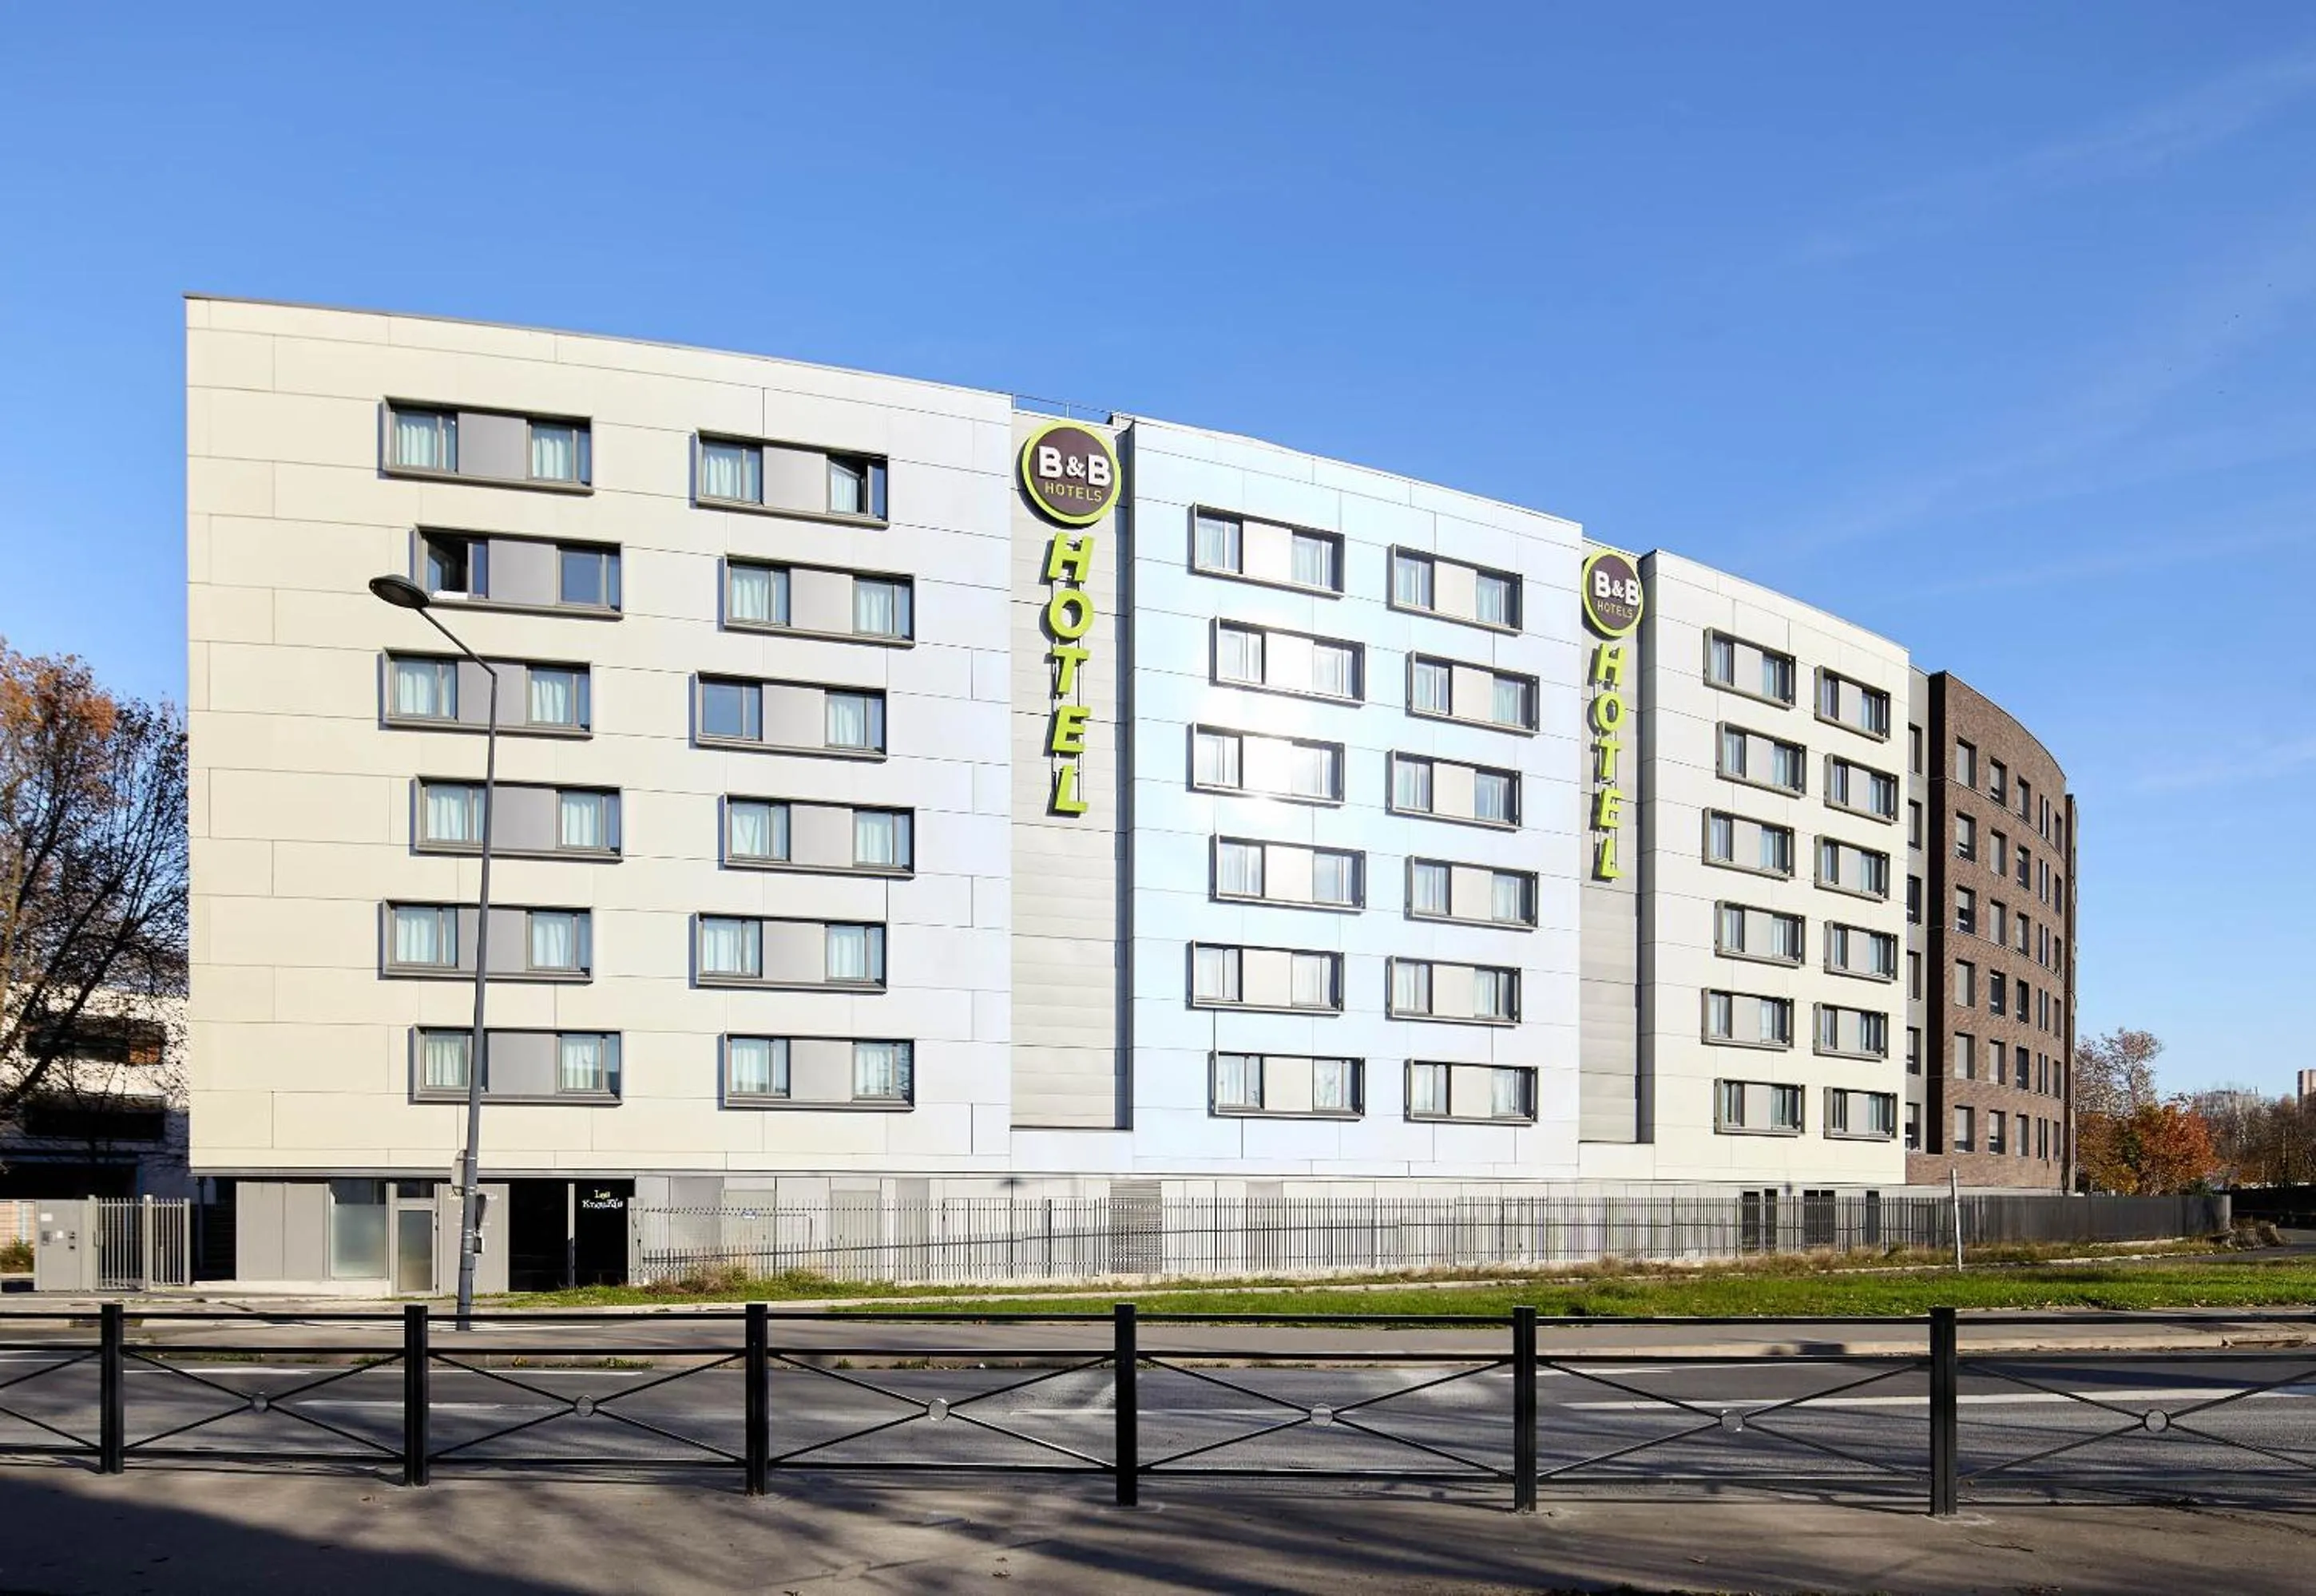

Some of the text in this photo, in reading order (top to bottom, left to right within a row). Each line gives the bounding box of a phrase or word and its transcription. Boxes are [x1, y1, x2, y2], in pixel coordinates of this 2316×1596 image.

[1038, 446, 1111, 487] B&B
[1045, 481, 1102, 501] HOTELS
[1594, 569, 1640, 607] B&B
[1597, 600, 1633, 619] HOTELS
[1047, 532, 1095, 814] HOTEL
[1596, 643, 1627, 879] HOTEL
